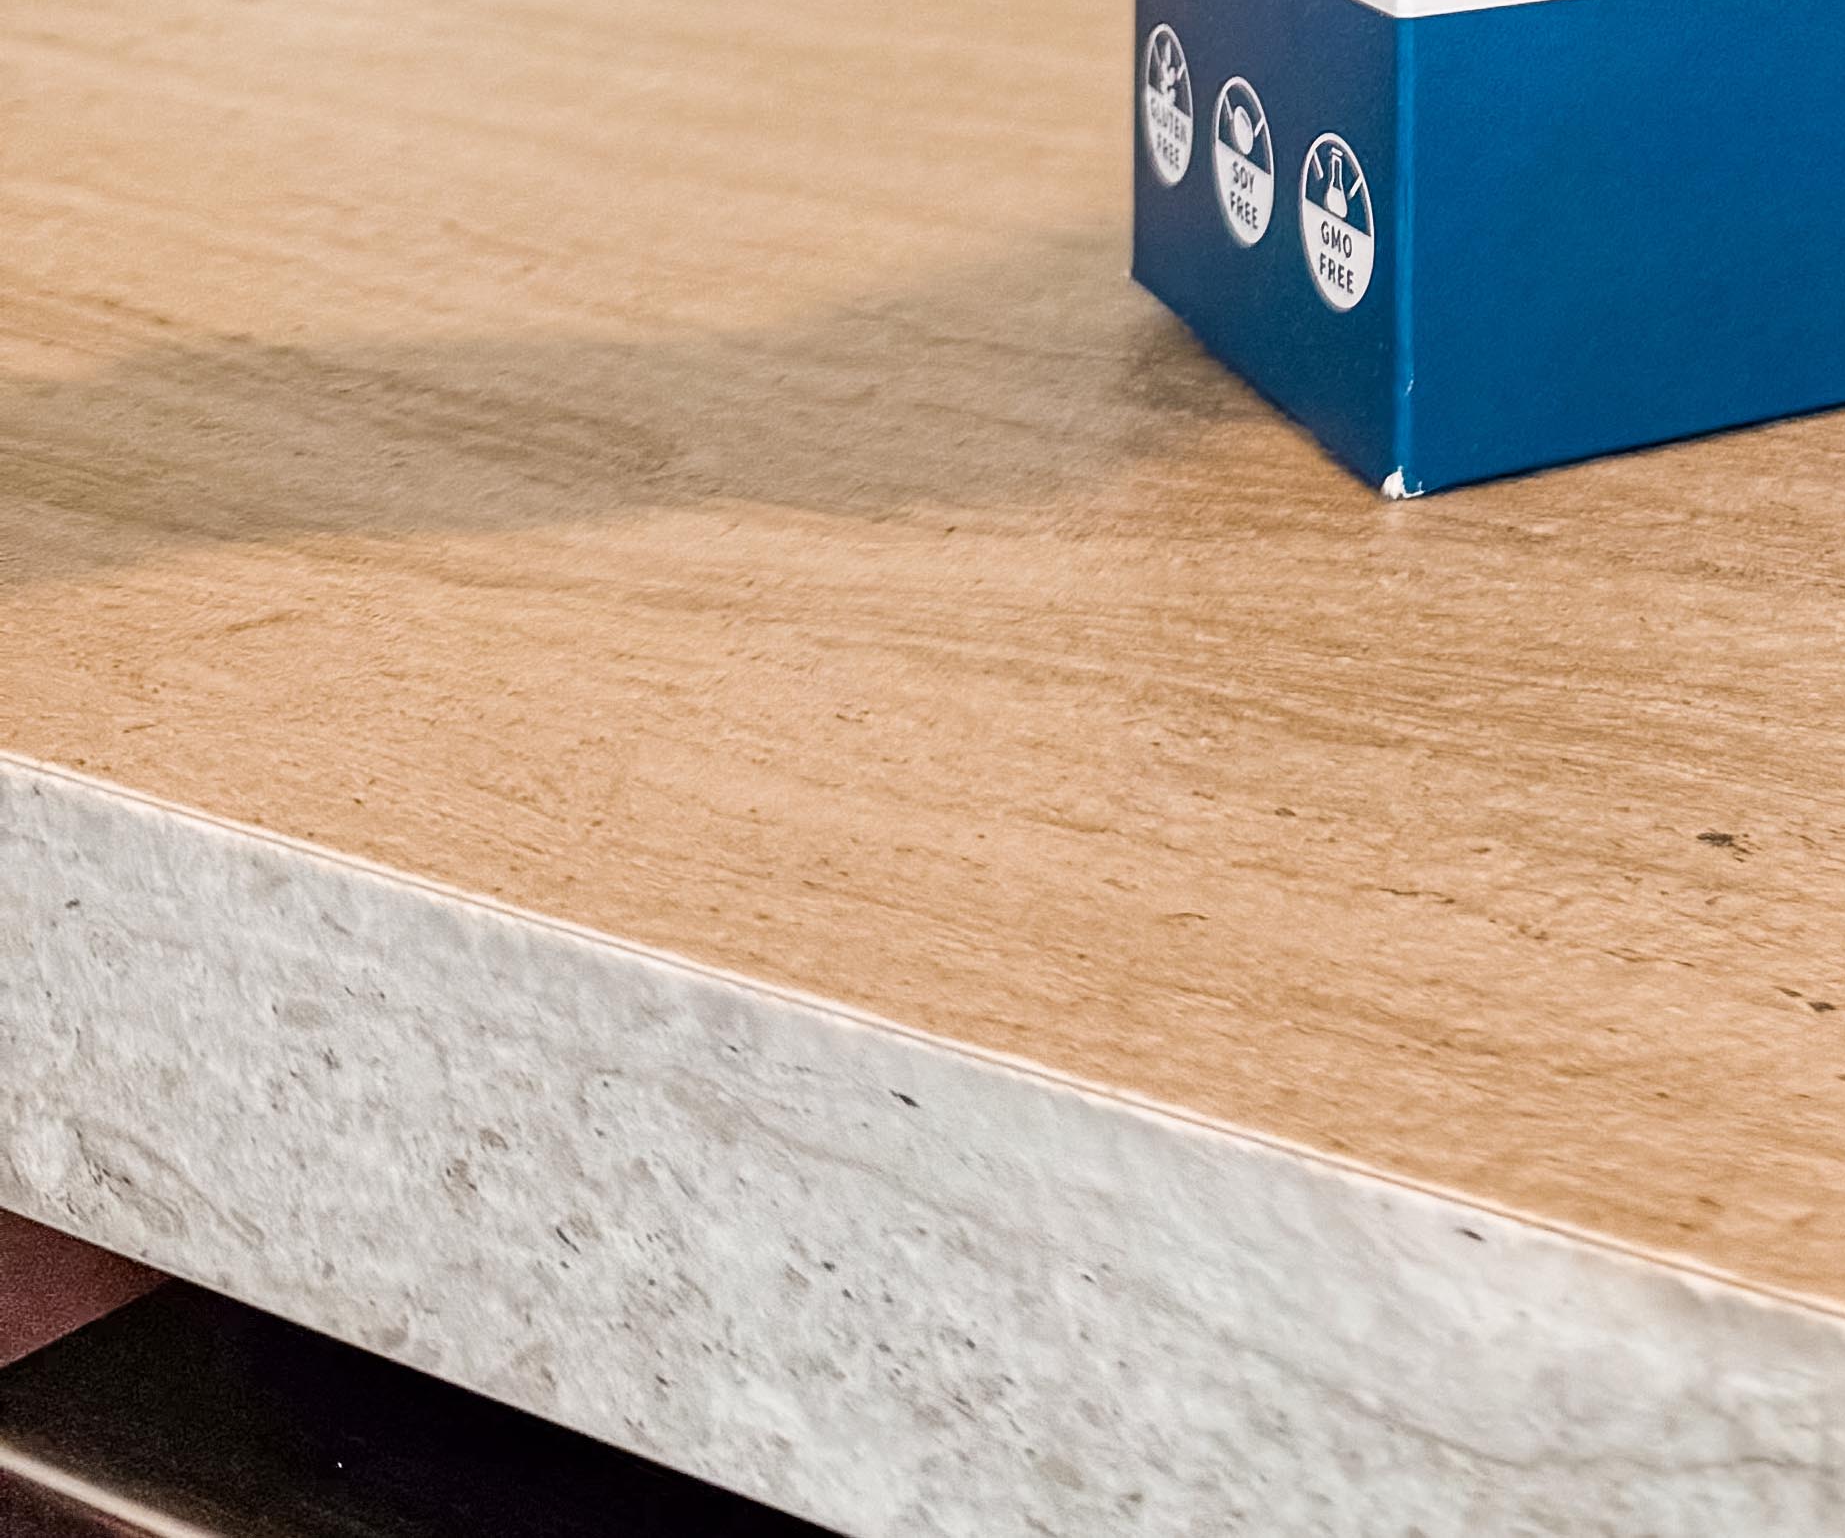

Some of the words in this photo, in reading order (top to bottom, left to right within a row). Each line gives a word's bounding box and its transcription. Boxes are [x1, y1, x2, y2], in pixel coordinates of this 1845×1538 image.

[1233, 161, 1255, 193] SOY
[1230, 191, 1258, 229] FREE
[1321, 220, 1352, 258] GMO
[1320, 252, 1354, 294] FREE
